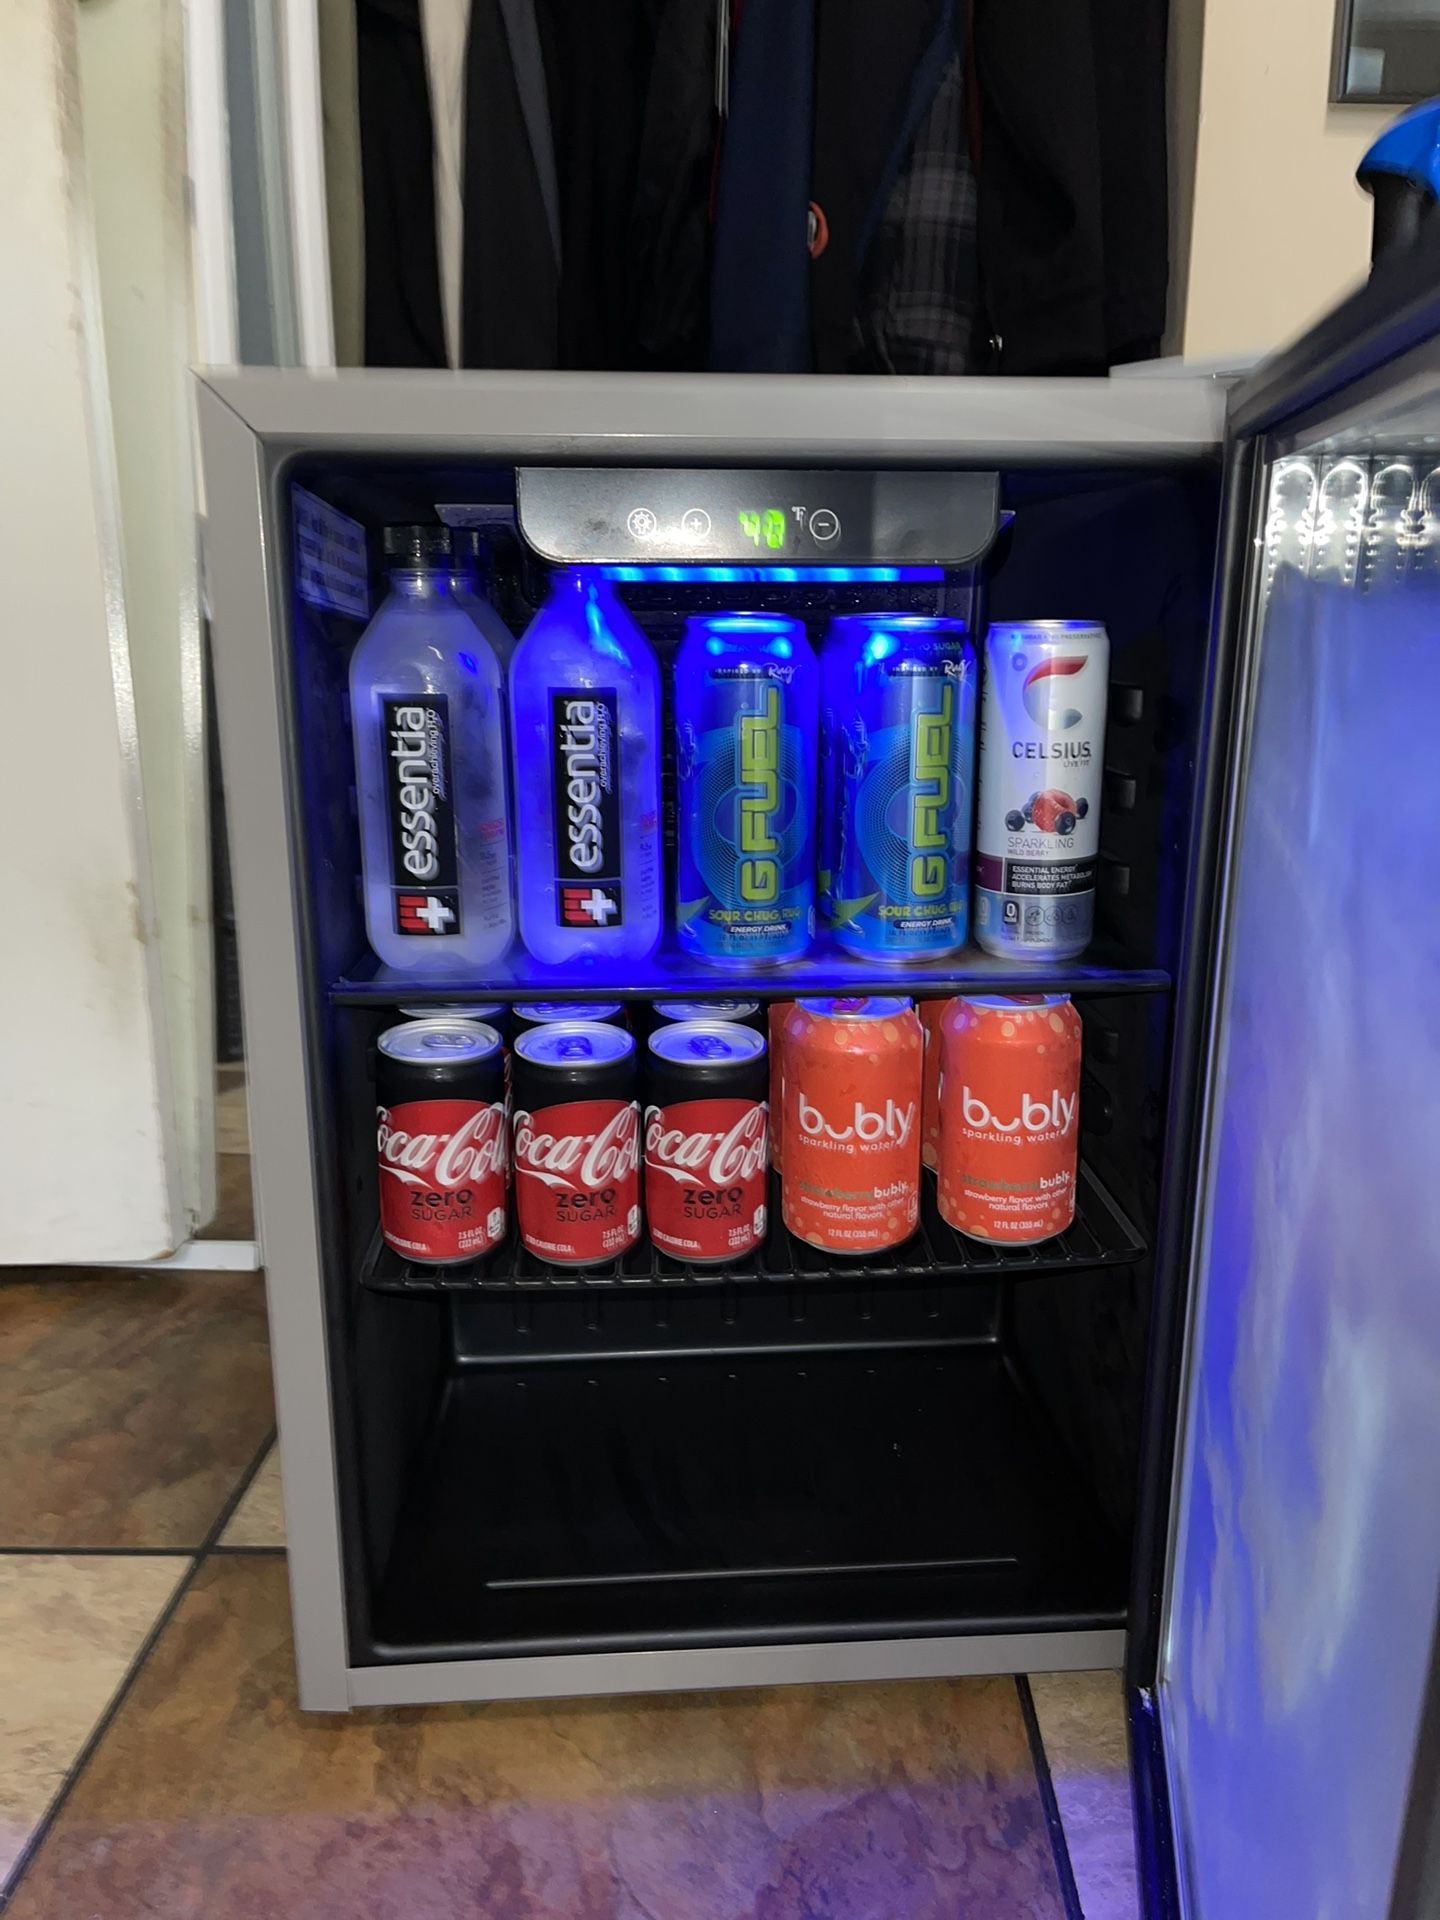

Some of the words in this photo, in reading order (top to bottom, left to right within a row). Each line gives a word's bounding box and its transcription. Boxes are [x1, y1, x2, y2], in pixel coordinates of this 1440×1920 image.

[1011, 740, 1092, 760] CELSIUS
[389, 705, 437, 878] essentia
[559, 700, 601, 871] essentia
[1007, 837, 1075, 849] SPARKLING
[1012, 865, 1050, 874] ESSENTIAL
[1011, 880, 1036, 889] BURNS
[708, 909, 740, 922] SOUR
[744, 909, 780, 922] CHUG
[878, 904, 911, 917] SOUR
[913, 903, 947, 916] CHUG
[731, 925, 762, 934] ENERGY
[900, 920, 931, 929] ENERGY
[798, 1134, 855, 1154] sparkling
[859, 1140, 897, 1152] water
[962, 1127, 1022, 1146] sparkling
[1026, 1130, 1060, 1143] water
[873, 1180, 909, 1199] bubly
[1039, 1170, 1071, 1190] bubly
[410, 1188, 473, 1208] zero
[555, 1187, 616, 1209] zero
[683, 1186, 743, 1206] zero
[411, 1206, 473, 1222] SUGAR
[556, 1204, 616, 1223] SUGAR
[683, 1203, 743, 1219] SUGAR
